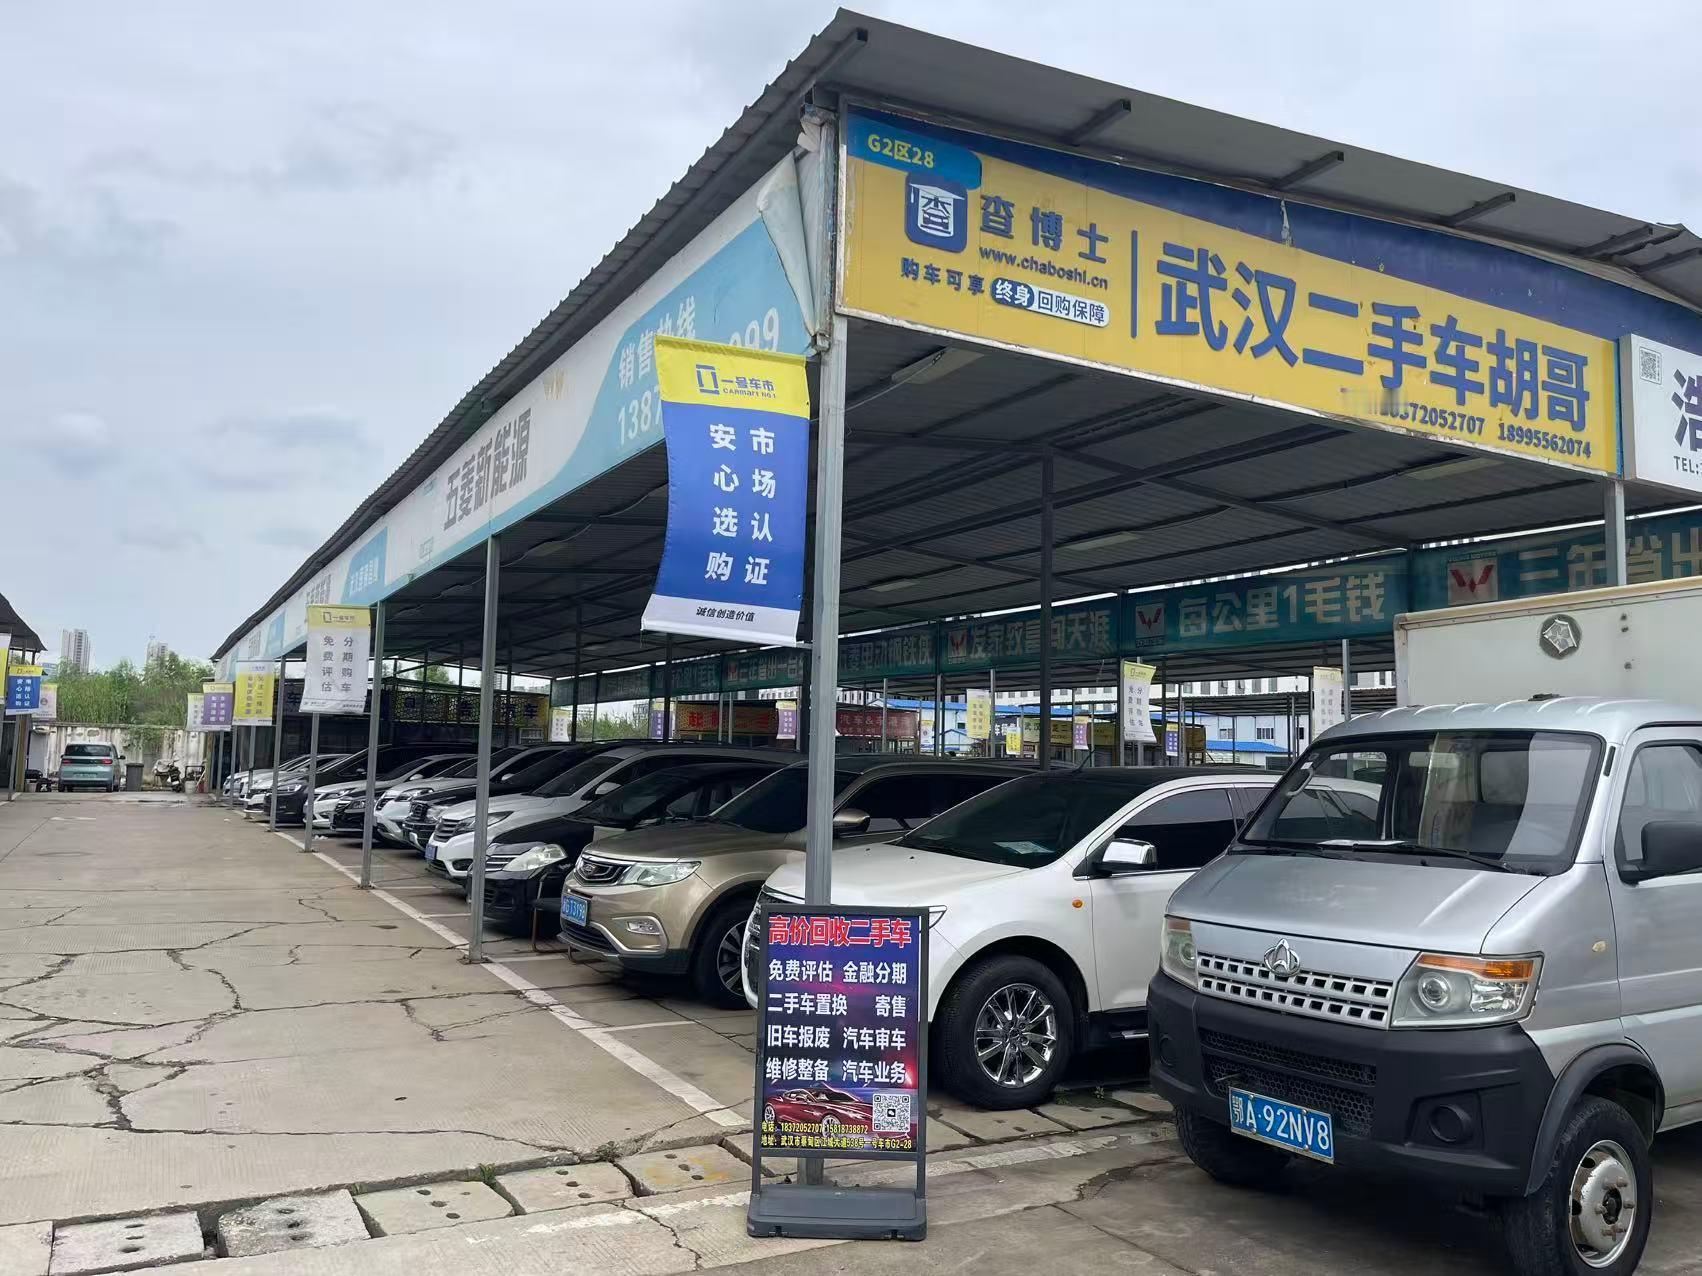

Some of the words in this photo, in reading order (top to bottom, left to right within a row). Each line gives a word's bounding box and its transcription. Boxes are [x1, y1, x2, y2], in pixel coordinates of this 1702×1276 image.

[868, 133, 934, 169] G2区28
[980, 194, 1109, 264] 查博士
[979, 246, 1109, 290] www.chaboshi.cn
[900, 257, 985, 296] 购车可享
[994, 279, 1031, 308] 终身
[1037, 291, 1106, 325] 回购保障
[1155, 241, 1590, 432] 武汉二手车胡哥
[720, 376, 775, 392] 一号车市
[1497, 421, 1592, 459] 18995562074
[444, 408, 532, 531] 五菱新能源
[705, 423, 740, 581] 安心选购
[745, 427, 776, 585] 市场认证
[696, 605, 756, 623] 诚信创造价值
[321, 635, 335, 692] 免费评估
[341, 636, 354, 693] 分期购车
[768, 916, 911, 948] 高价回收二手车
[768, 959, 832, 983] 免费评估
[842, 961, 907, 985] 金融分期
[767, 992, 847, 1016] 二手车置换
[875, 995, 907, 1018] 寄售
[767, 1025, 831, 1048] 旧车报废
[842, 1027, 906, 1050] 汽车审车
[766, 1058, 829, 1082] 维修整备
[842, 1061, 906, 1084] 汽车业务
[1232, 1095, 1330, 1150] 鄂A·92NV8
